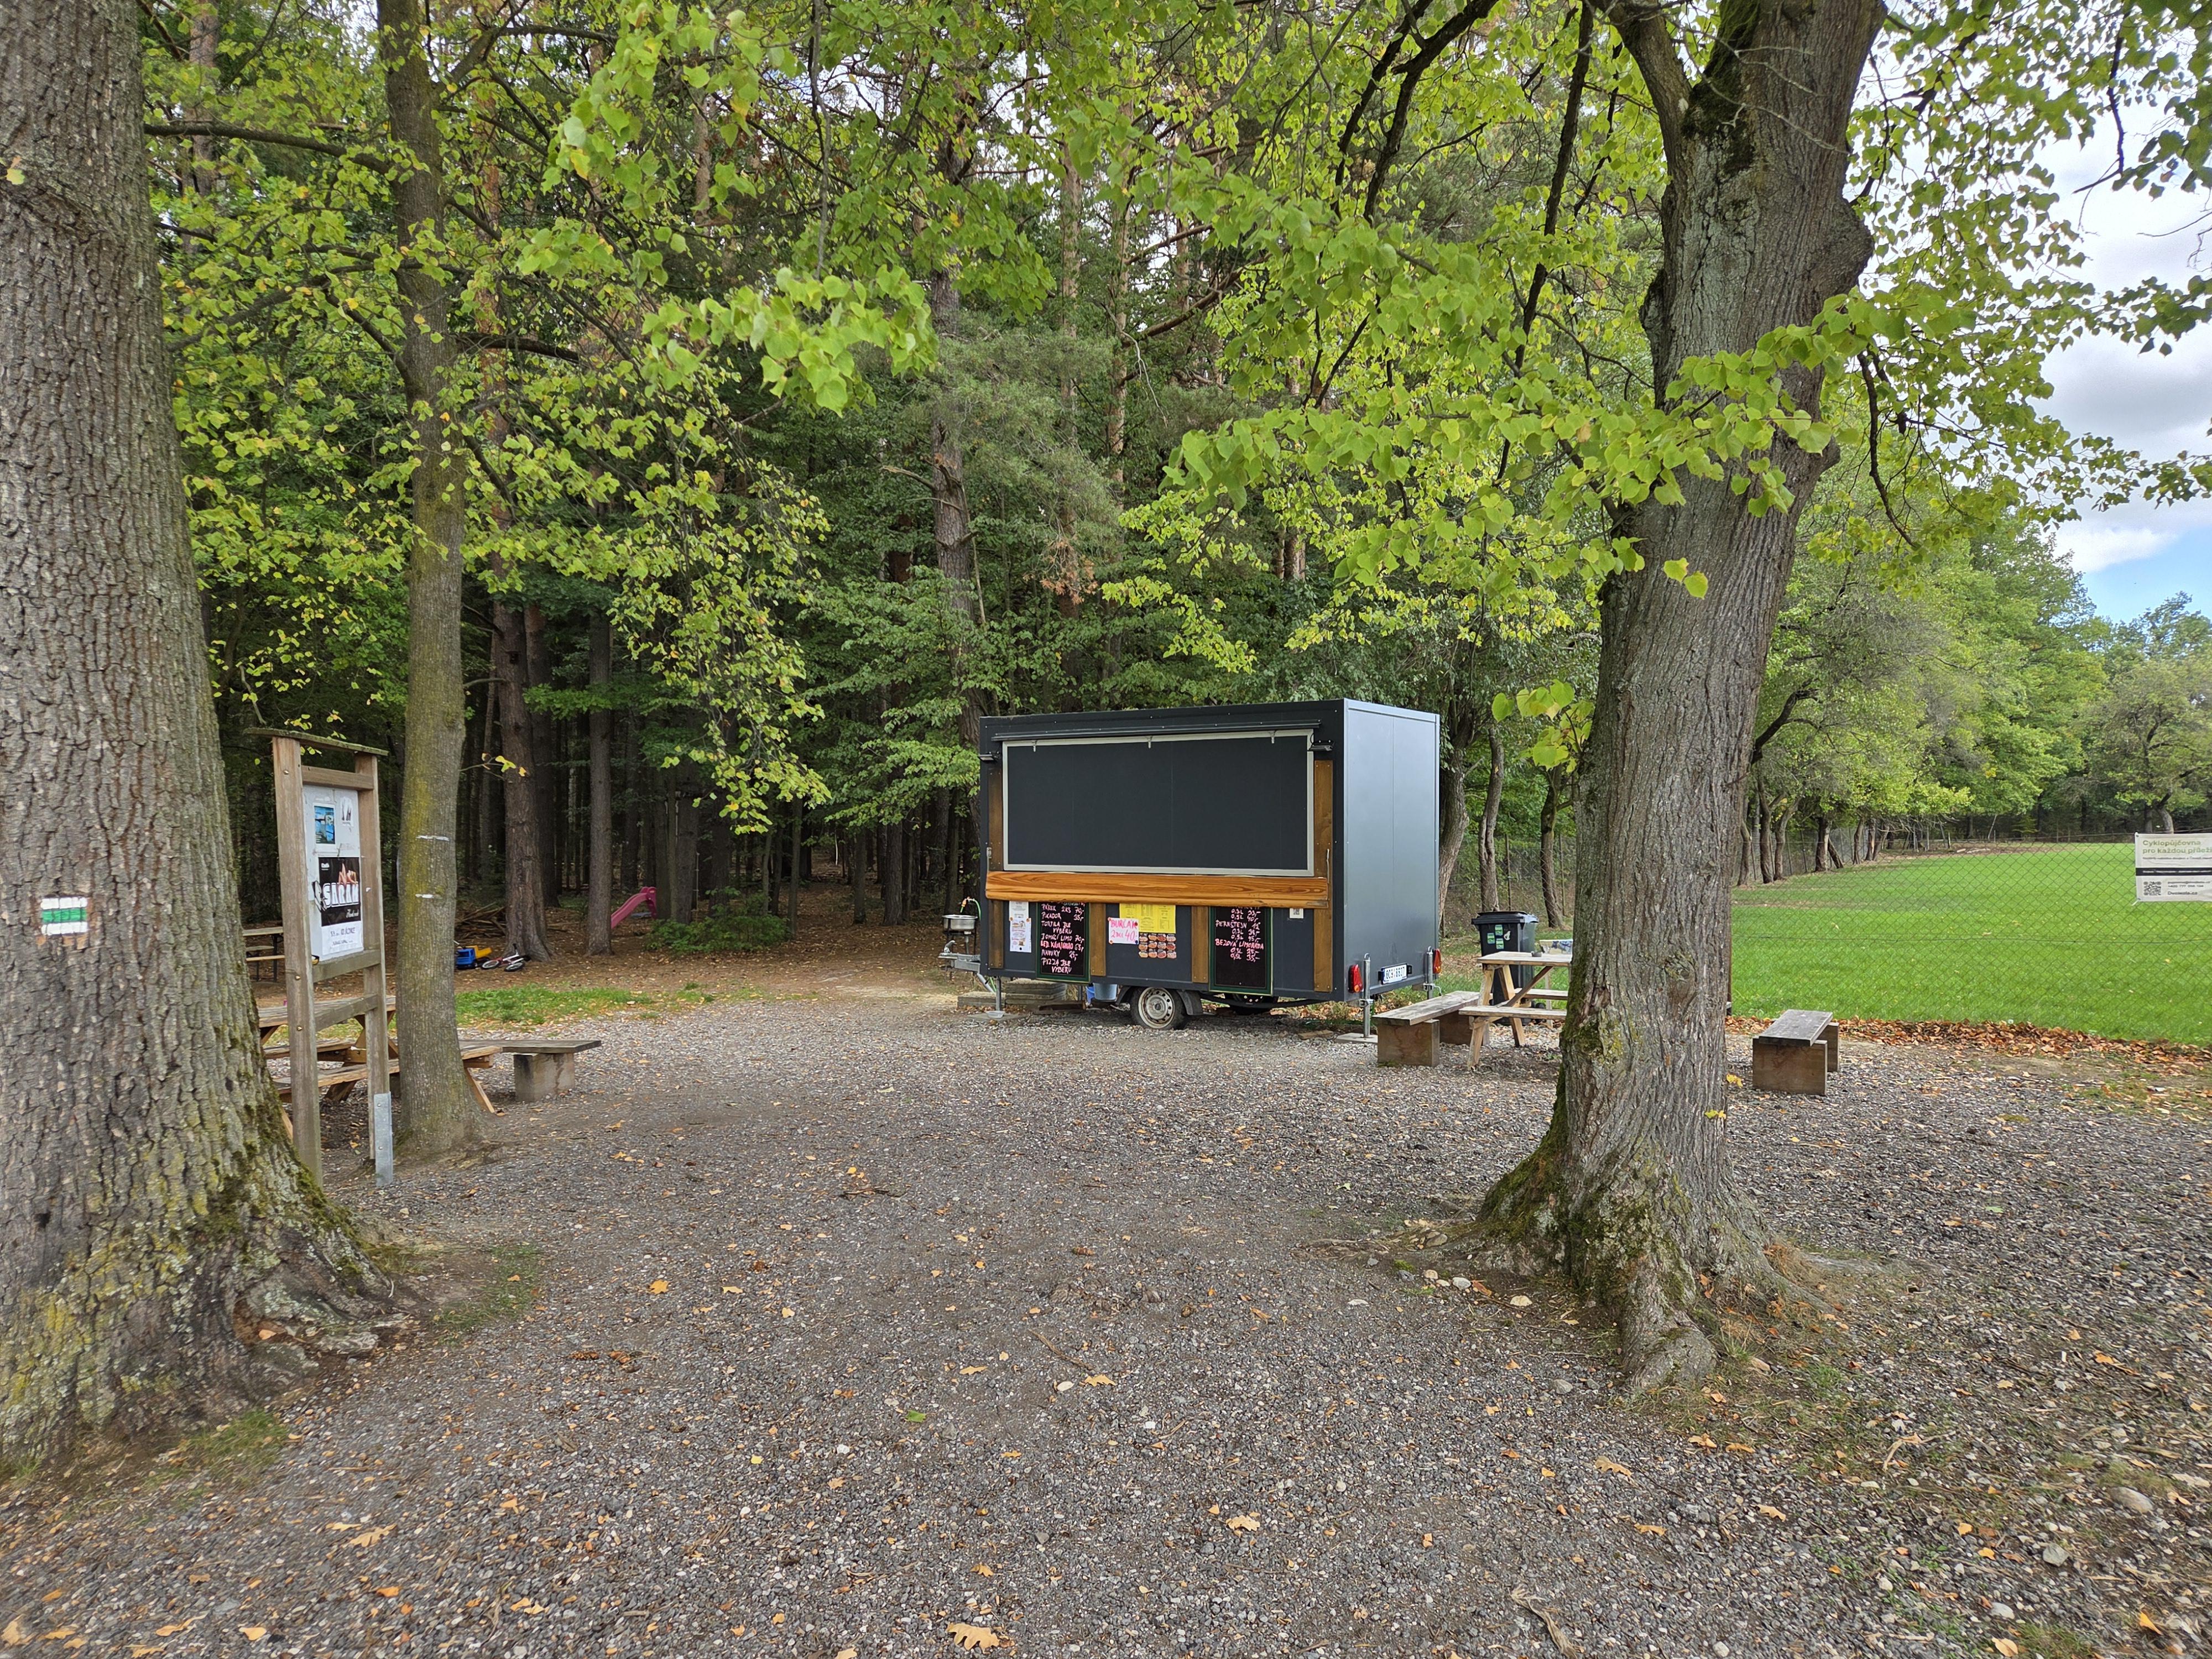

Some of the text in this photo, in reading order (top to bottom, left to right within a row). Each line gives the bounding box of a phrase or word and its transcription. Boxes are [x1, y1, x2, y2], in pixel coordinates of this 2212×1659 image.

[1041, 911, 1061, 920] PIKADOR
[1111, 919, 1138, 930] BURČÁK
[1214, 938, 1238, 947] BEZOVÁ
[1041, 957, 1060, 967] PIZZA
